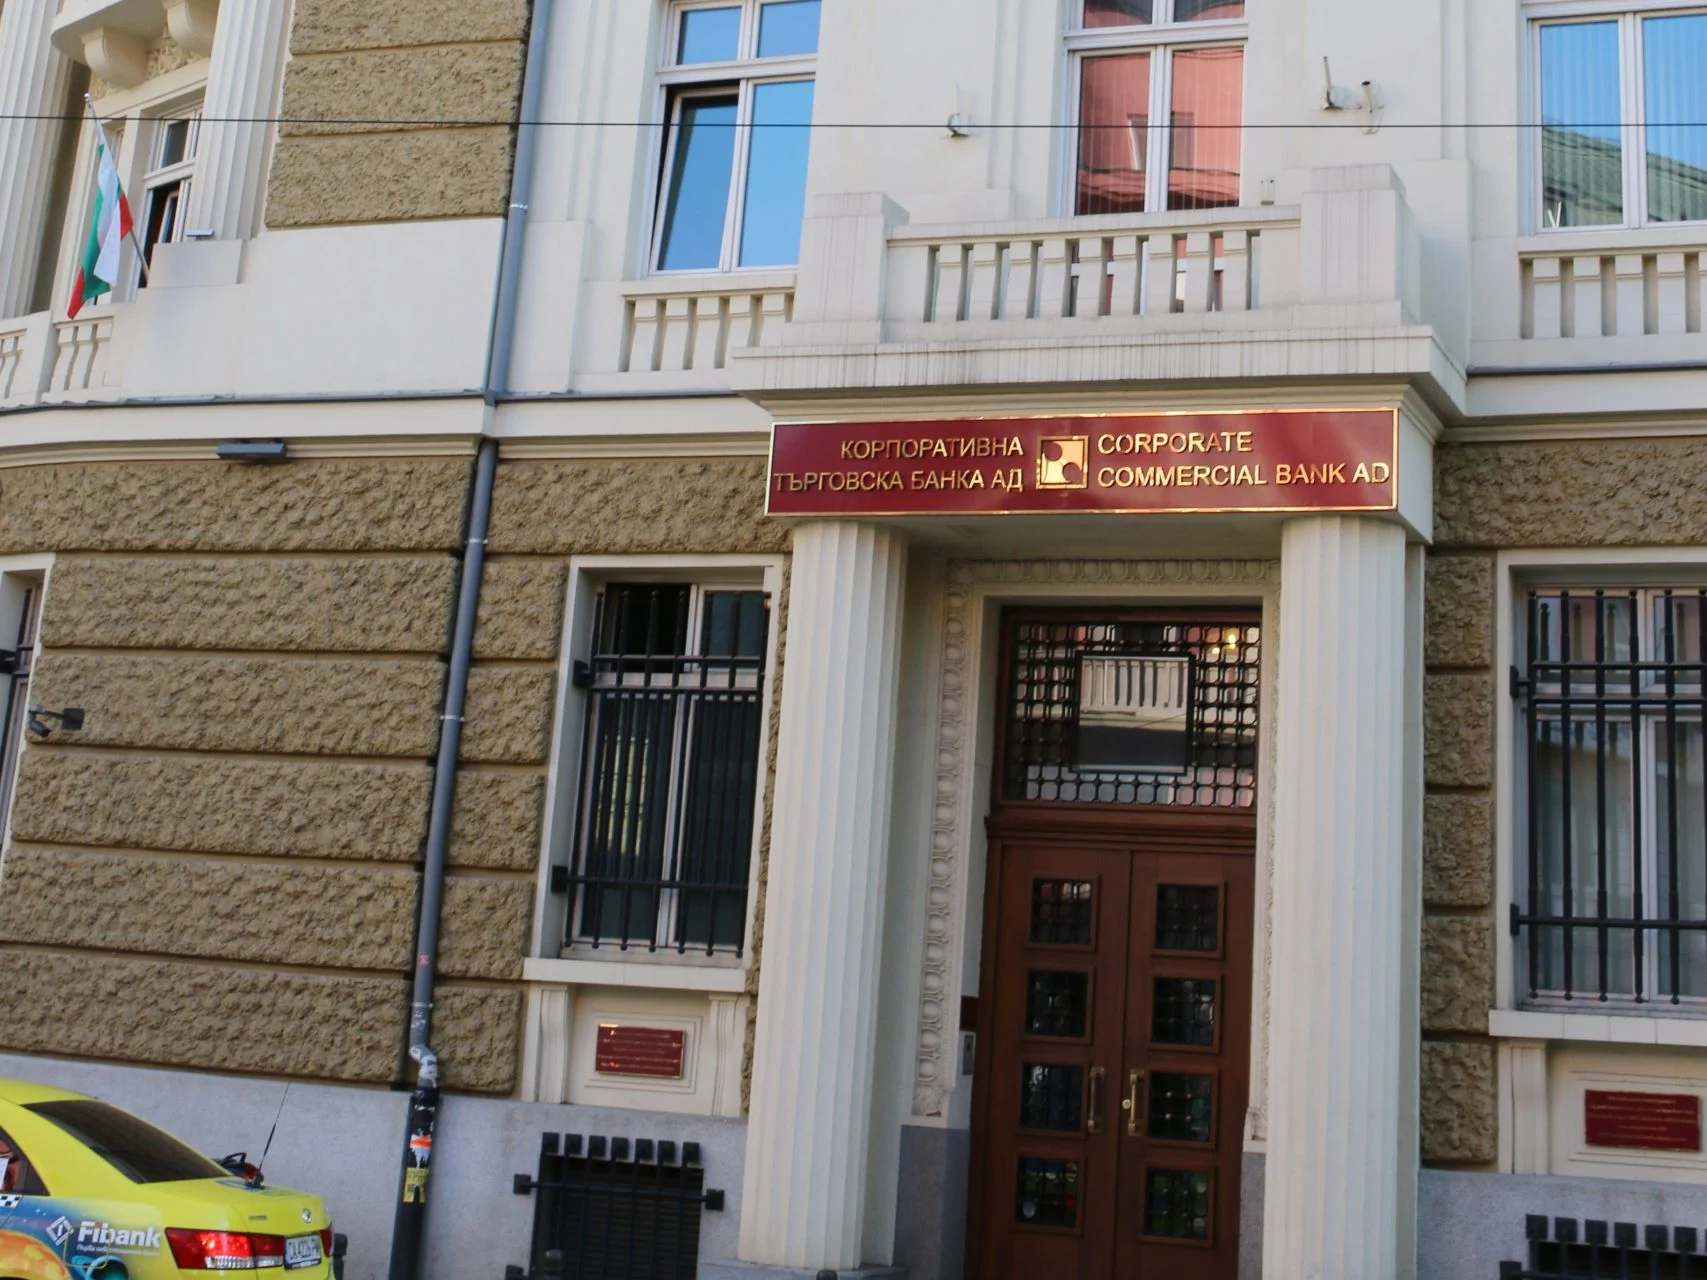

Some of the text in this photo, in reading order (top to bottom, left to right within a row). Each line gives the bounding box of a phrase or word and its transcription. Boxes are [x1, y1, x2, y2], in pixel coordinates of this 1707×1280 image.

[841, 436, 1024, 459] КОРПОРАТИВНА
[1097, 431, 1253, 455] CORPORATE
[773, 467, 1024, 492] ТЪРГОВСКА БАНКА АД
[1097, 462, 1390, 488] COMMERCIAL BANK AD
[77, 1221, 162, 1248] Fibank
